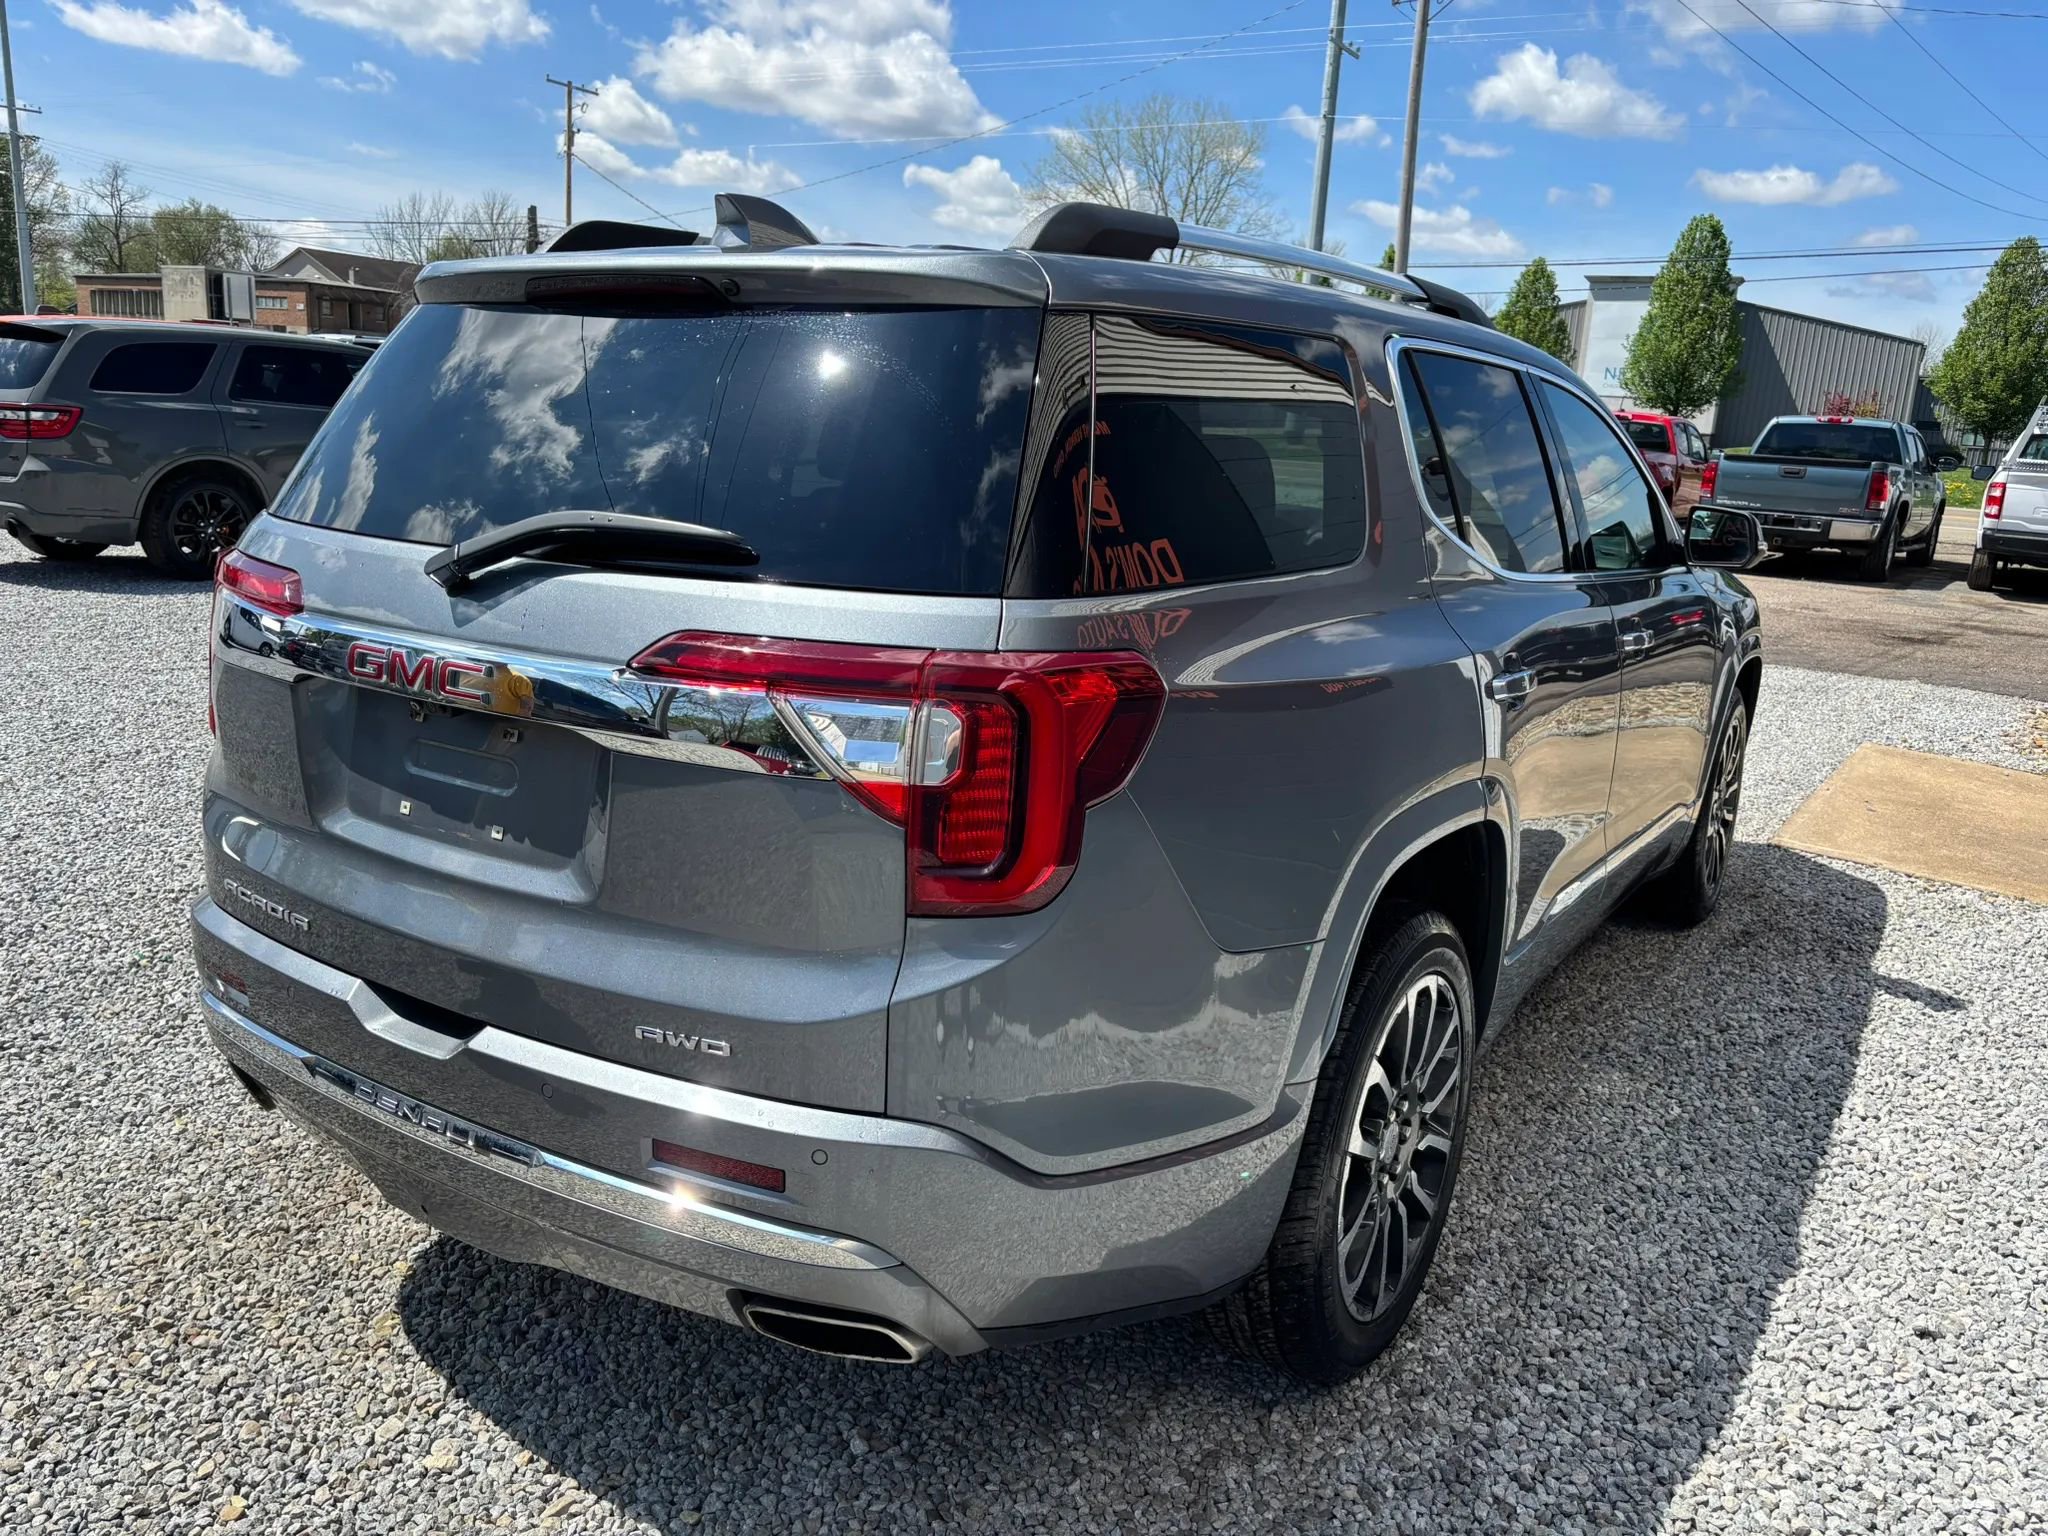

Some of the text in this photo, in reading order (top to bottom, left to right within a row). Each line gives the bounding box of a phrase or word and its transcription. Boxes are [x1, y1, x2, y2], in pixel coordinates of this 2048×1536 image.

[347, 640, 495, 706] GMC
[223, 878, 310, 931] ACADIA
[634, 1025, 732, 1057] AWD
[353, 1082, 476, 1146] DENALI
